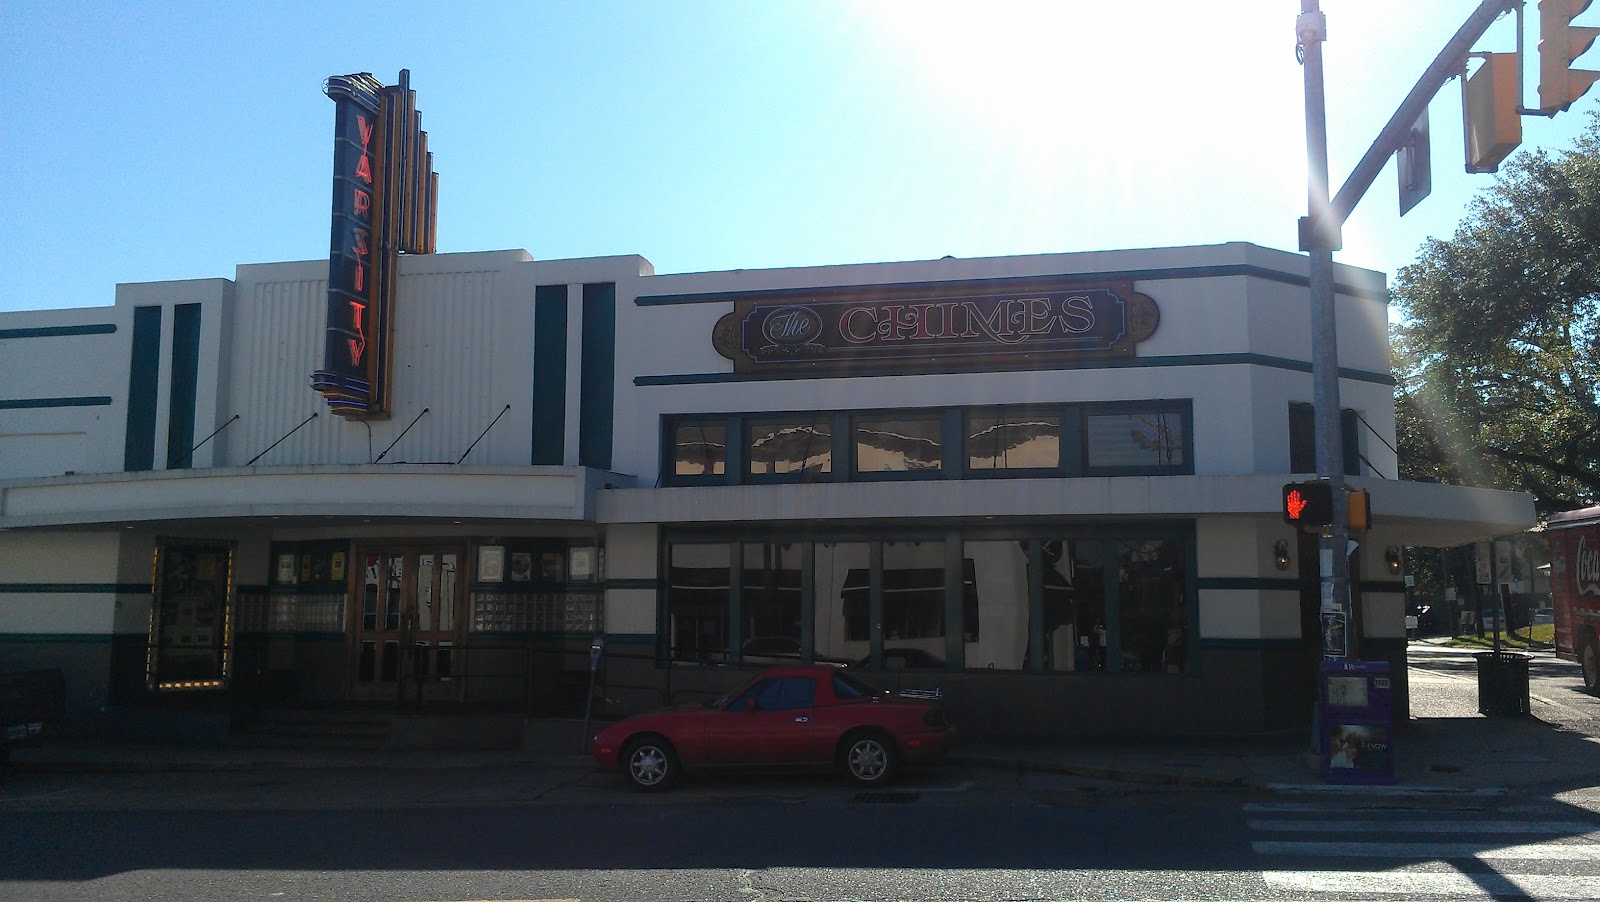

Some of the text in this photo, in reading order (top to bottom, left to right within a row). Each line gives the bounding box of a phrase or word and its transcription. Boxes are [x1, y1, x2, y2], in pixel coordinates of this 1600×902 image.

[348, 113, 374, 368] VARSITY
[769, 295, 1095, 344] The CHIMES
